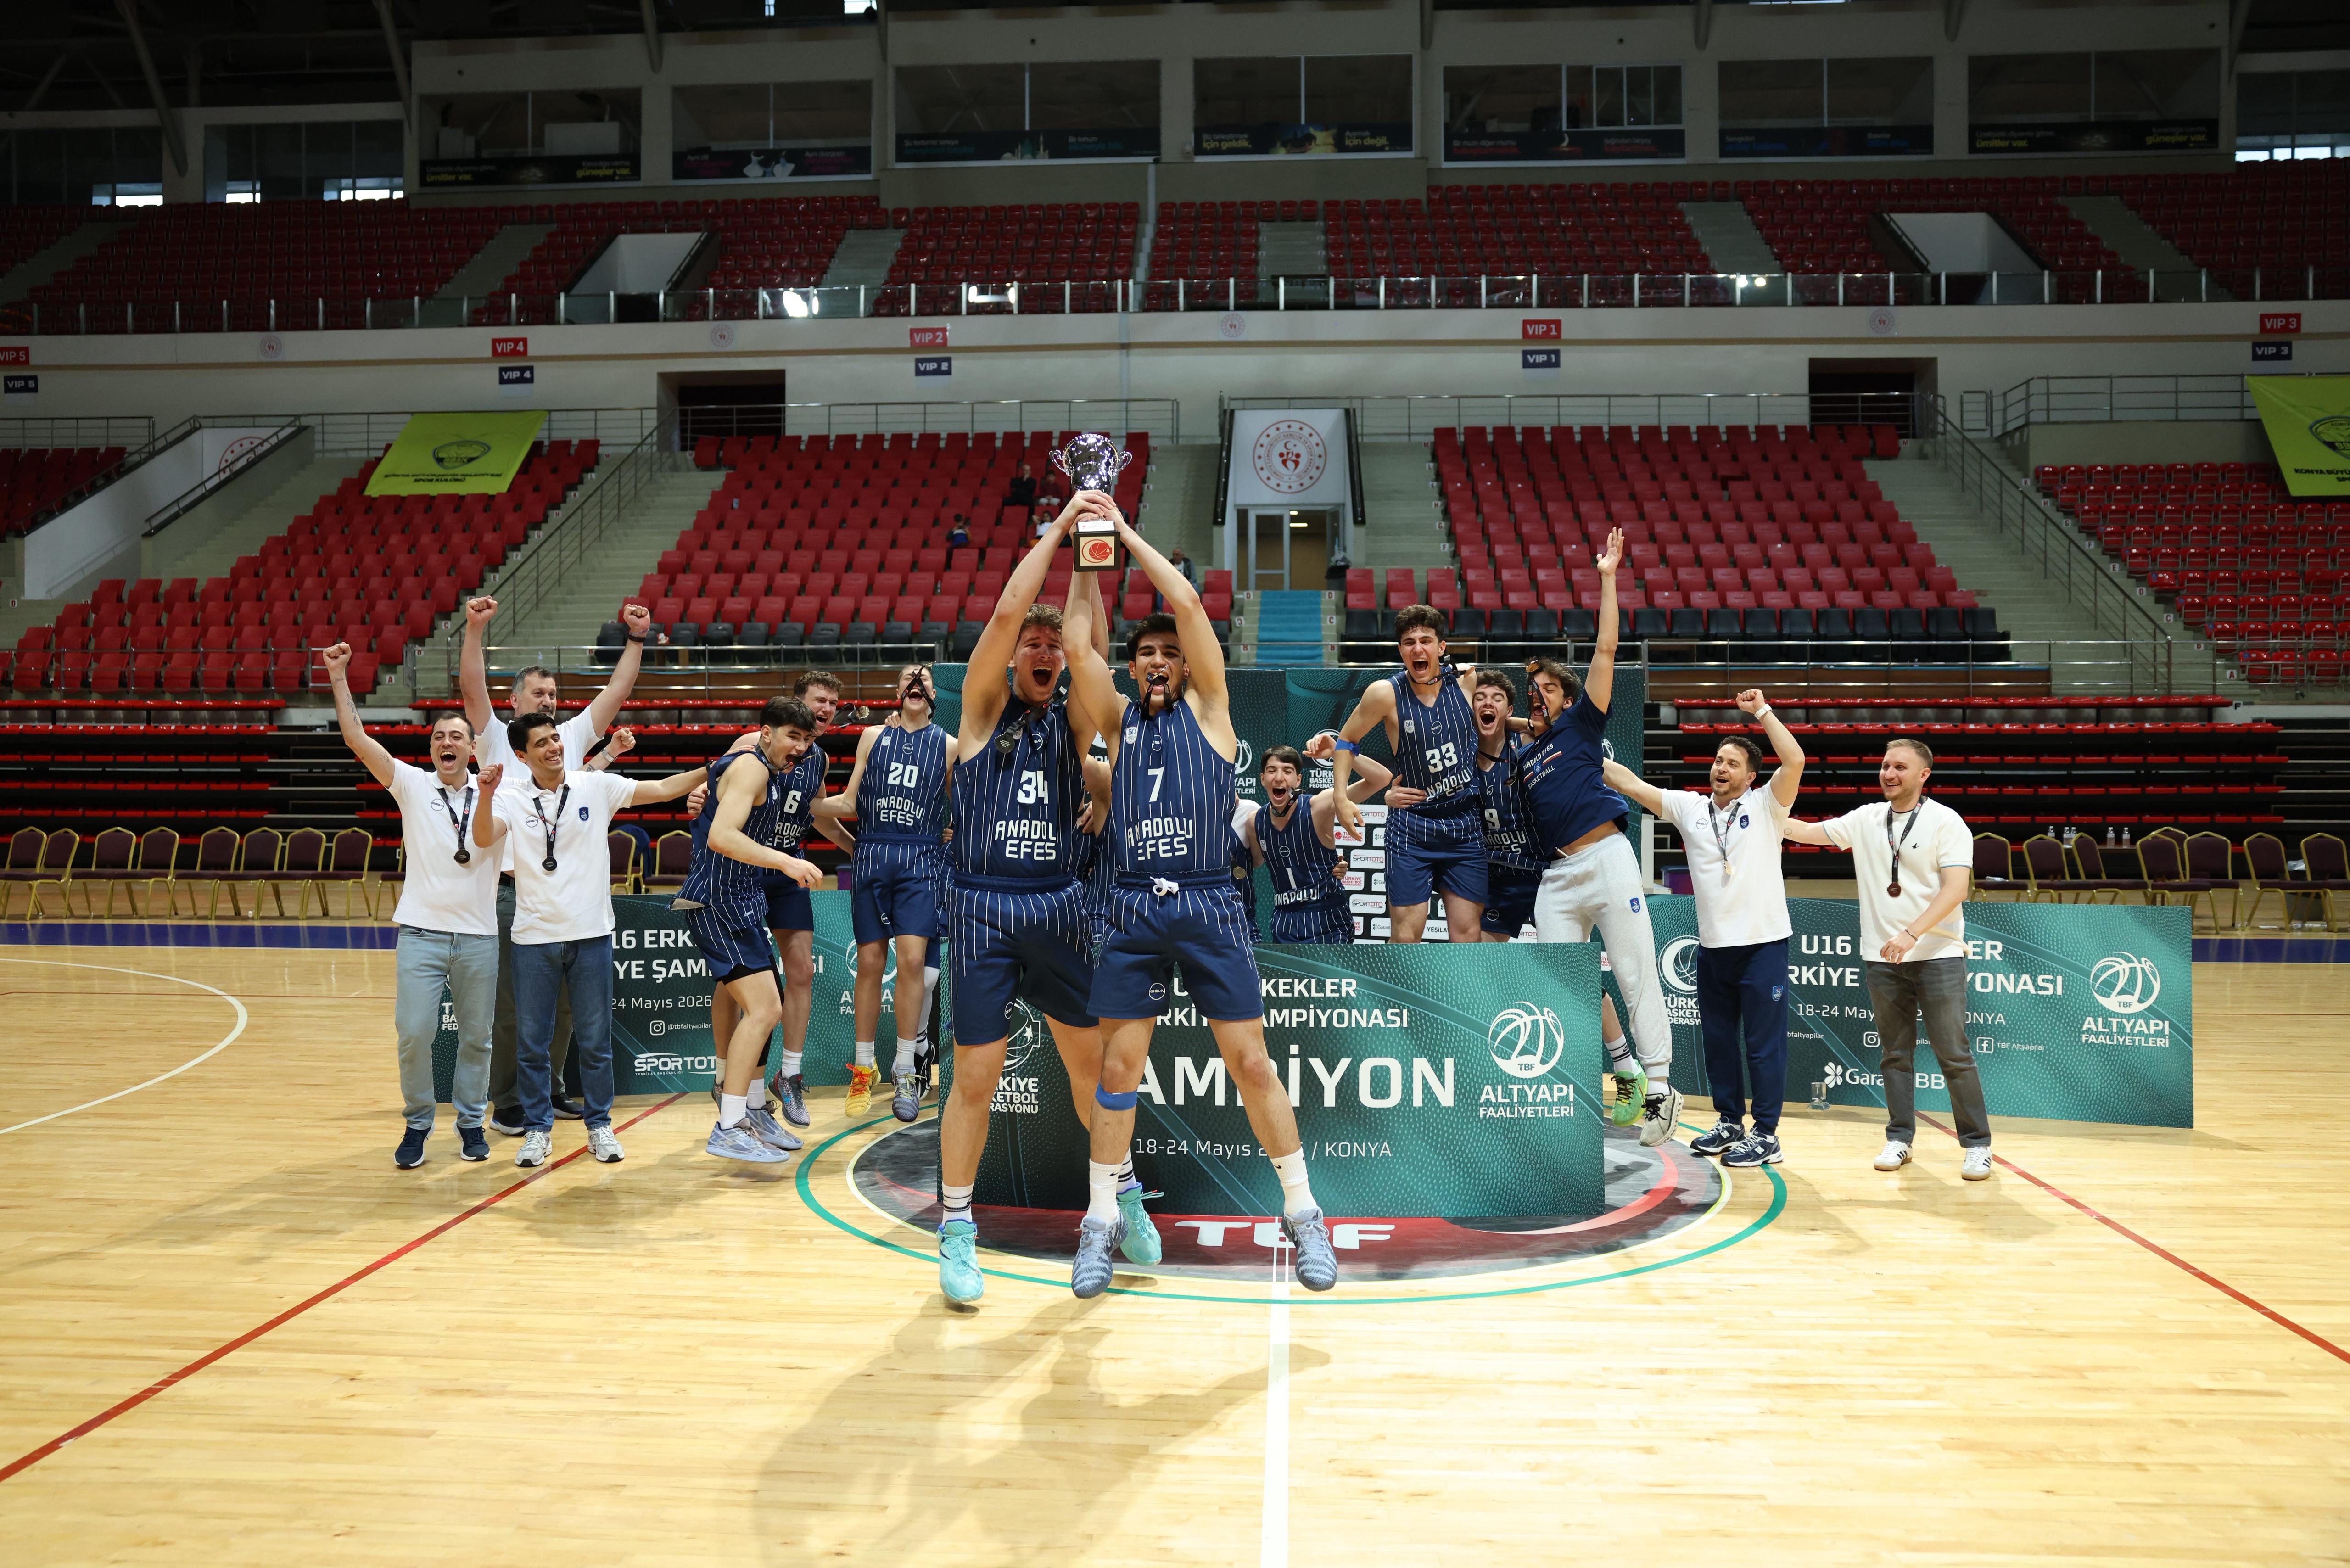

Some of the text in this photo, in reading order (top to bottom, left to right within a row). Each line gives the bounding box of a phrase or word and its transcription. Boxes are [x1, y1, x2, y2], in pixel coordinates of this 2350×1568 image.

[1527, 324, 1557, 335] VIP 1
[2265, 318, 2297, 329] VIP 3
[914, 331, 943, 343] VIP 2
[496, 341, 524, 353] VIP 4
[2256, 346, 2289, 355] VIP 3
[0, 351, 26, 361] VIP 5
[1528, 354, 1547, 363] VIP
[918, 362, 948, 371] VIP 2
[502, 370, 531, 380] VIP 4
[2229, 671, 2235, 679] A
[1426, 742, 1458, 773] 33
[1542, 743, 1554, 756] EFES
[887, 762, 919, 788] 20
[1528, 766, 1555, 790] BASKETBALL
[1017, 770, 1049, 804] 34
[1147, 766, 1164, 802] 7
[783, 790, 802, 814] 6
[876, 796, 923, 819] ANADOLU
[774, 812, 805, 836] ADOL
[880, 809, 914, 826] EFES
[1485, 809, 1500, 829] 9
[1006, 840, 1056, 860] EFES
[1138, 837, 1188, 861] EFES
[1286, 868, 1297, 889] 1
[1274, 889, 1319, 907] ANADOLU
[1802, 935, 1851, 955] U16
[632, 997, 673, 1011] Mayıs
[678, 995, 711, 1008] 2026
[1664, 994, 1699, 1009] ÜRK
[1667, 1009, 1700, 1017] ASKET
[1797, 1004, 1840, 1017] 18-24
[667, 1022, 711, 1032] @tbfaltyapilar
[2082, 1016, 2170, 1035] ALTYAPI
[2082, 1033, 2169, 1047] FAALİYETLERİ
[1480, 1084, 1574, 1103] ALTYAPI
[1480, 1103, 1574, 1118] FAALİYETLERİ
[1136, 1138, 1188, 1154] 18-24
[1196, 1140, 1250, 1160] Mayıs
[1311, 1142, 1318, 1160] /
[1326, 1142, 1392, 1157] KONYA
